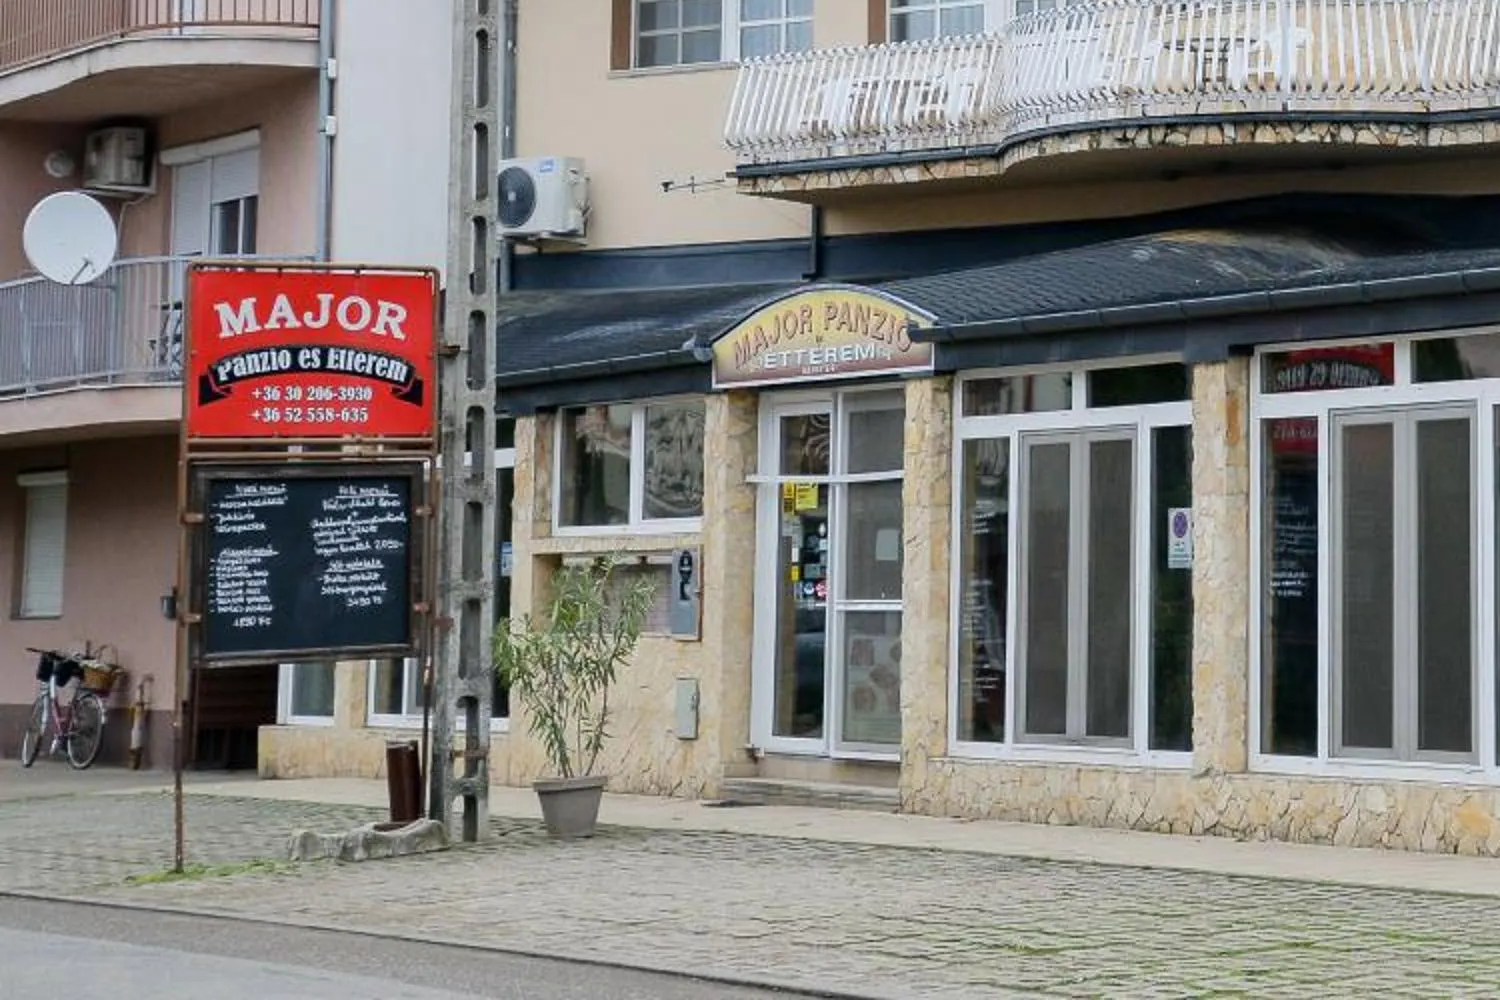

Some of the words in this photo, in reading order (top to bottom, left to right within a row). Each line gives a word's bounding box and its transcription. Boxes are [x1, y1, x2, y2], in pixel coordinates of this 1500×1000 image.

[213, 293, 407, 341] MAJOR
[733, 304, 813, 374] MAJOR
[251, 386, 281, 401] +36
[285, 386, 302, 401] 30
[250, 407, 280, 423] +36
[285, 407, 301, 422] 52
[306, 407, 369, 423] 558-635
